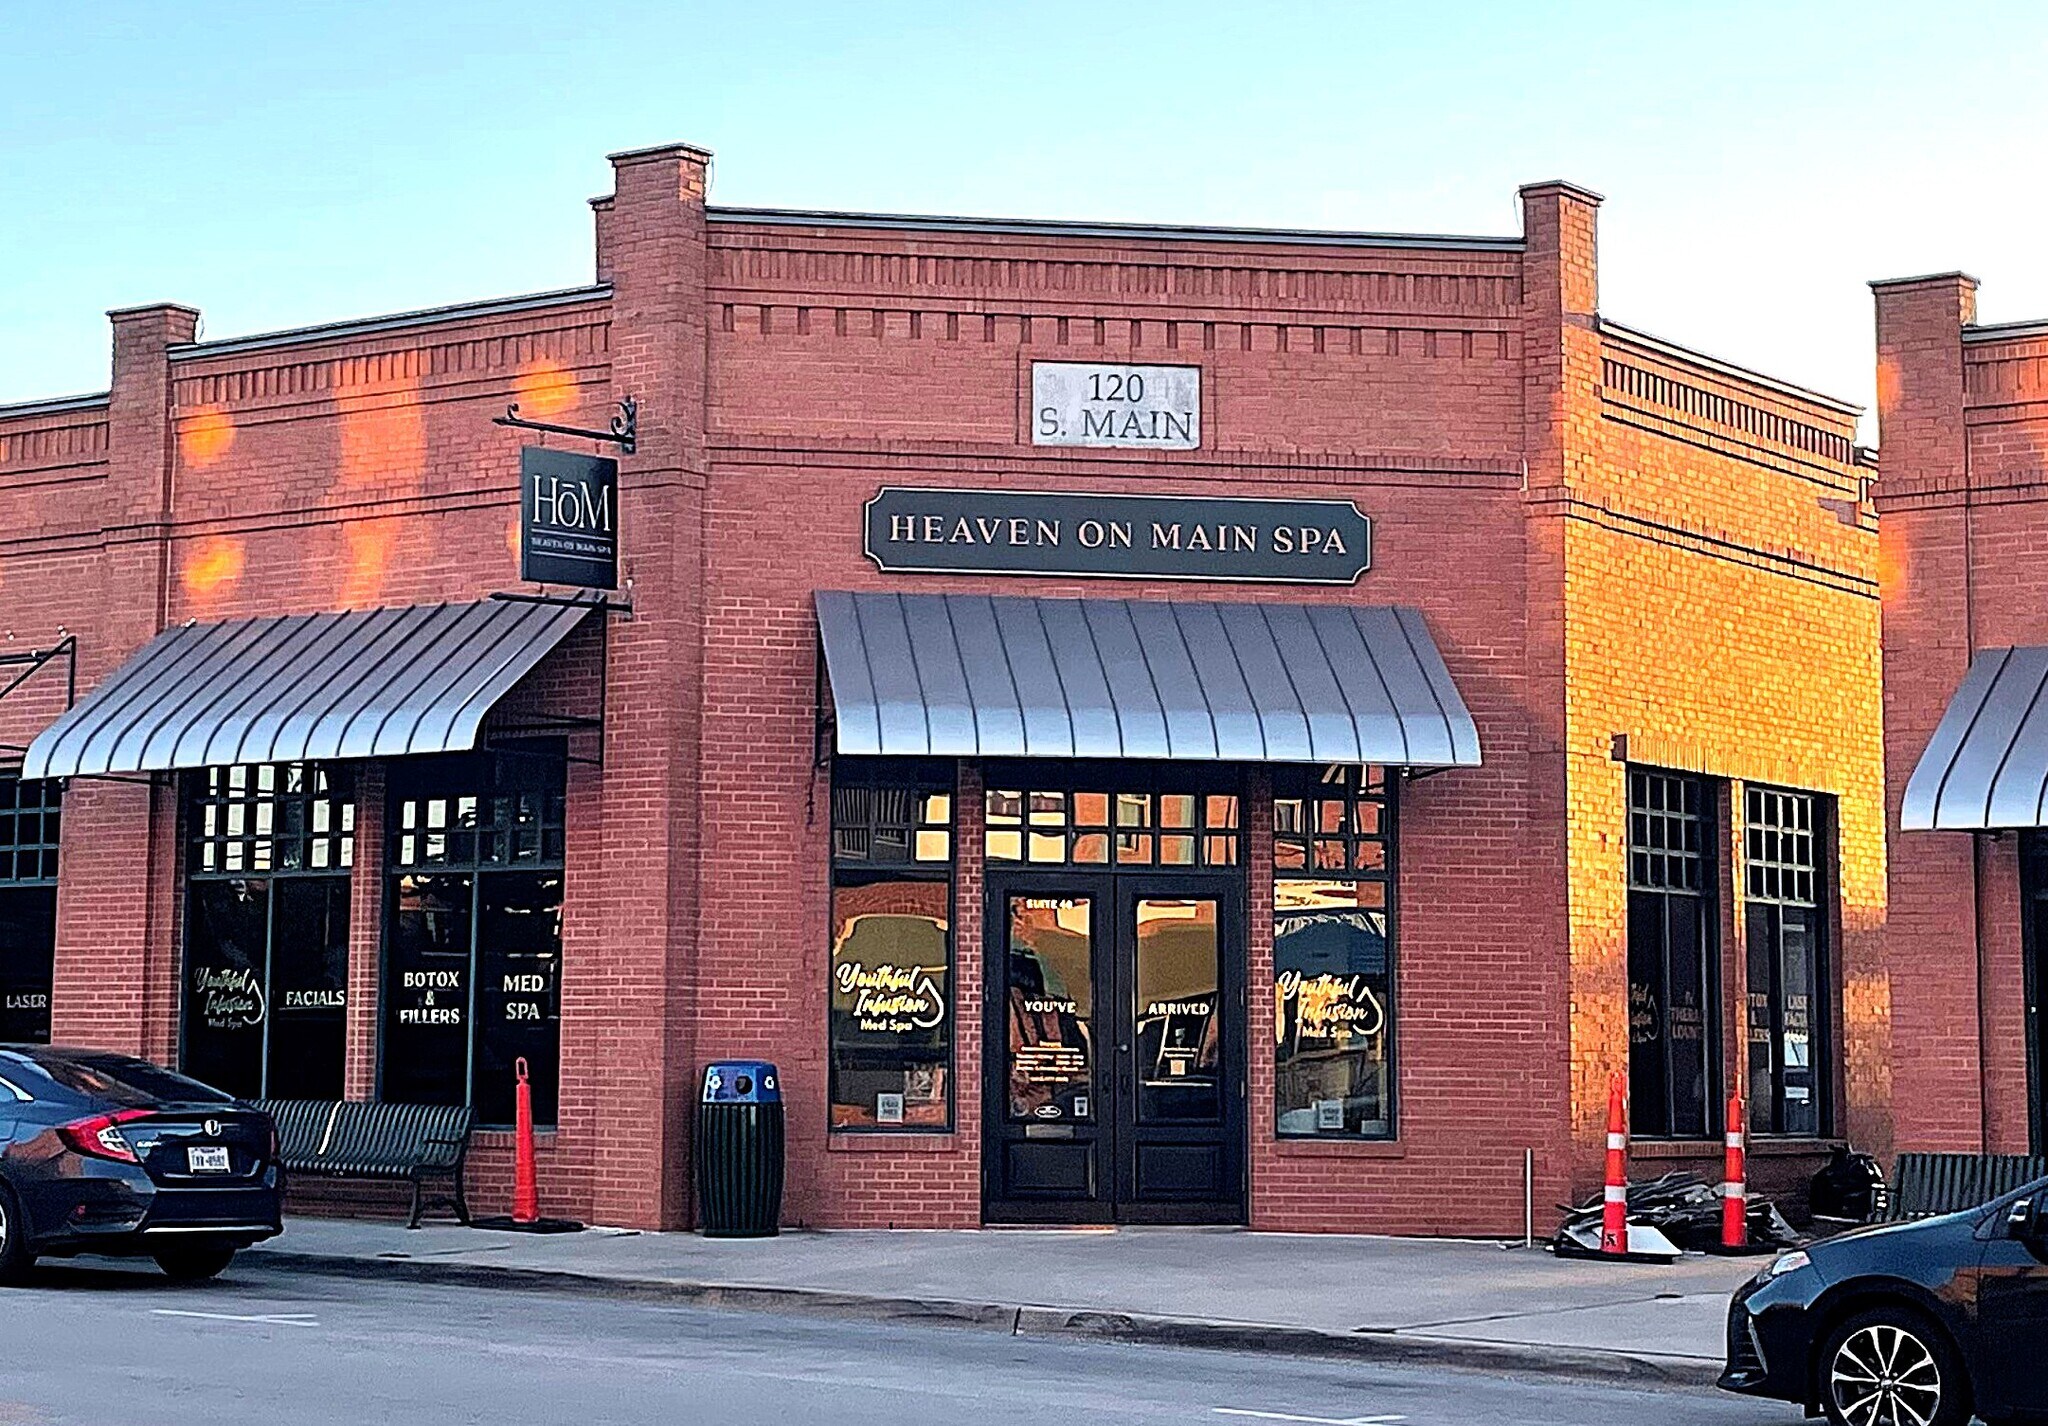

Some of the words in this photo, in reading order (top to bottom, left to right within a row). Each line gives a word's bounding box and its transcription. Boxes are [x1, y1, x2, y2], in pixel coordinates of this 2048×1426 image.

[1089, 373, 1144, 403] 120
[1039, 407, 1067, 437] S.
[1081, 409, 1193, 441] MAIN
[889, 514, 1060, 547] HEAVEN
[1078, 520, 1132, 549] ON
[1151, 523, 1257, 552] MAIN
[1273, 526, 1347, 555] SPA
[403, 971, 460, 988] BOTOX
[503, 974, 545, 992] MED
[836, 962, 921, 993] Youthful
[1278, 970, 1360, 1000] Youthful
[6, 994, 47, 1009] LASER
[286, 989, 345, 1006] FACIALS
[425, 989, 435, 1006] &
[853, 988, 930, 1017] Infusion
[505, 1002, 541, 1021] SPA
[1024, 1000, 1077, 1014] YOU'VE
[1148, 1002, 1210, 1016] ARRIVED
[1294, 997, 1369, 1023] Infusion
[400, 1008, 460, 1025] FILLERS
[860, 1018, 887, 1031] Med
[889, 1018, 913, 1034] Spa
